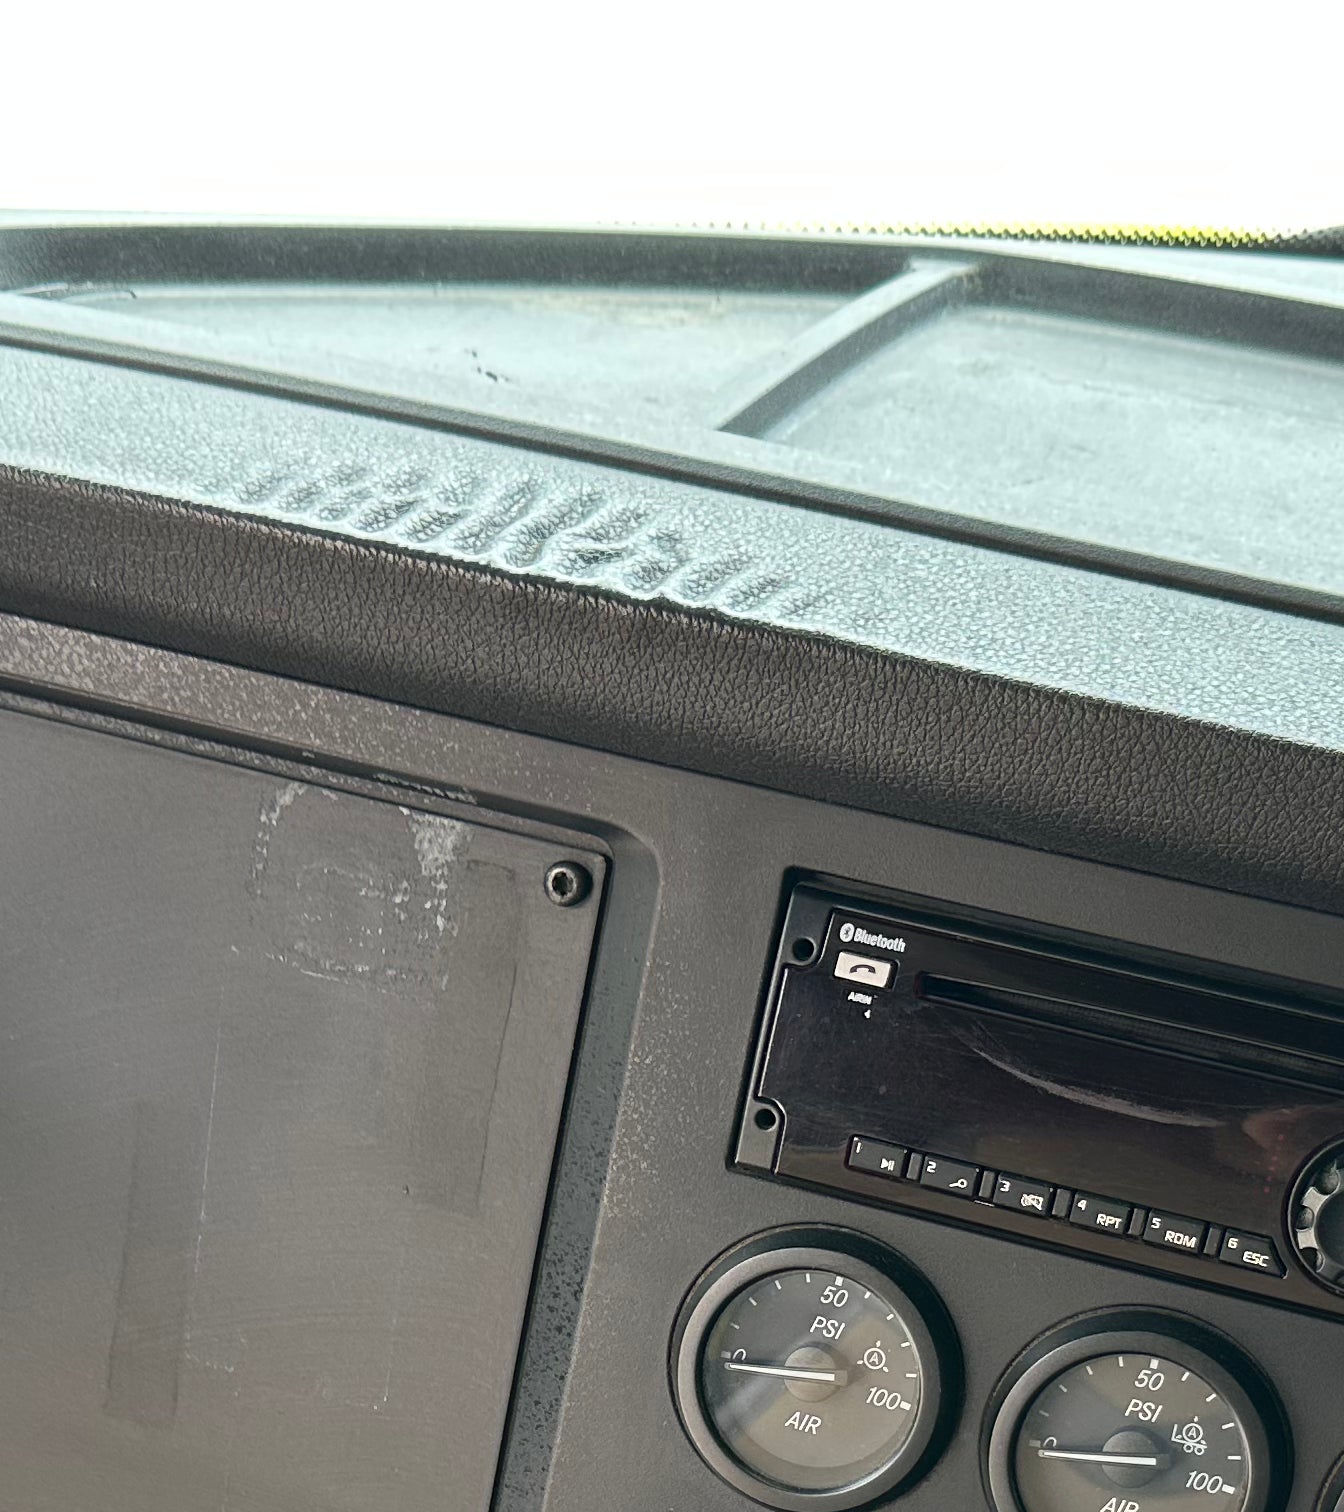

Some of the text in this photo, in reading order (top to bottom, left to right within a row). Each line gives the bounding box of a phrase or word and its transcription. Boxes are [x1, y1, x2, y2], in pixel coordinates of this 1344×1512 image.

[854, 927, 906, 953] Bluetooth
[926, 1160, 937, 1173] 2
[1000, 1180, 1011, 1192] 3
[1077, 1199, 1087, 1211] 4
[1096, 1213, 1123, 1229] RPT
[1151, 1217, 1161, 1229] 5
[1164, 1230, 1197, 1249] RDM
[1227, 1237, 1238, 1249] 6
[1242, 1250, 1270, 1267] ESC
[820, 1285, 849, 1308] 50
[809, 1315, 846, 1340] PSI
[1134, 1369, 1164, 1391] 50
[865, 1386, 901, 1411] 100
[1124, 1399, 1162, 1423] PSI
[784, 1411, 822, 1435] AIR
[1185, 1470, 1223, 1494] 100
